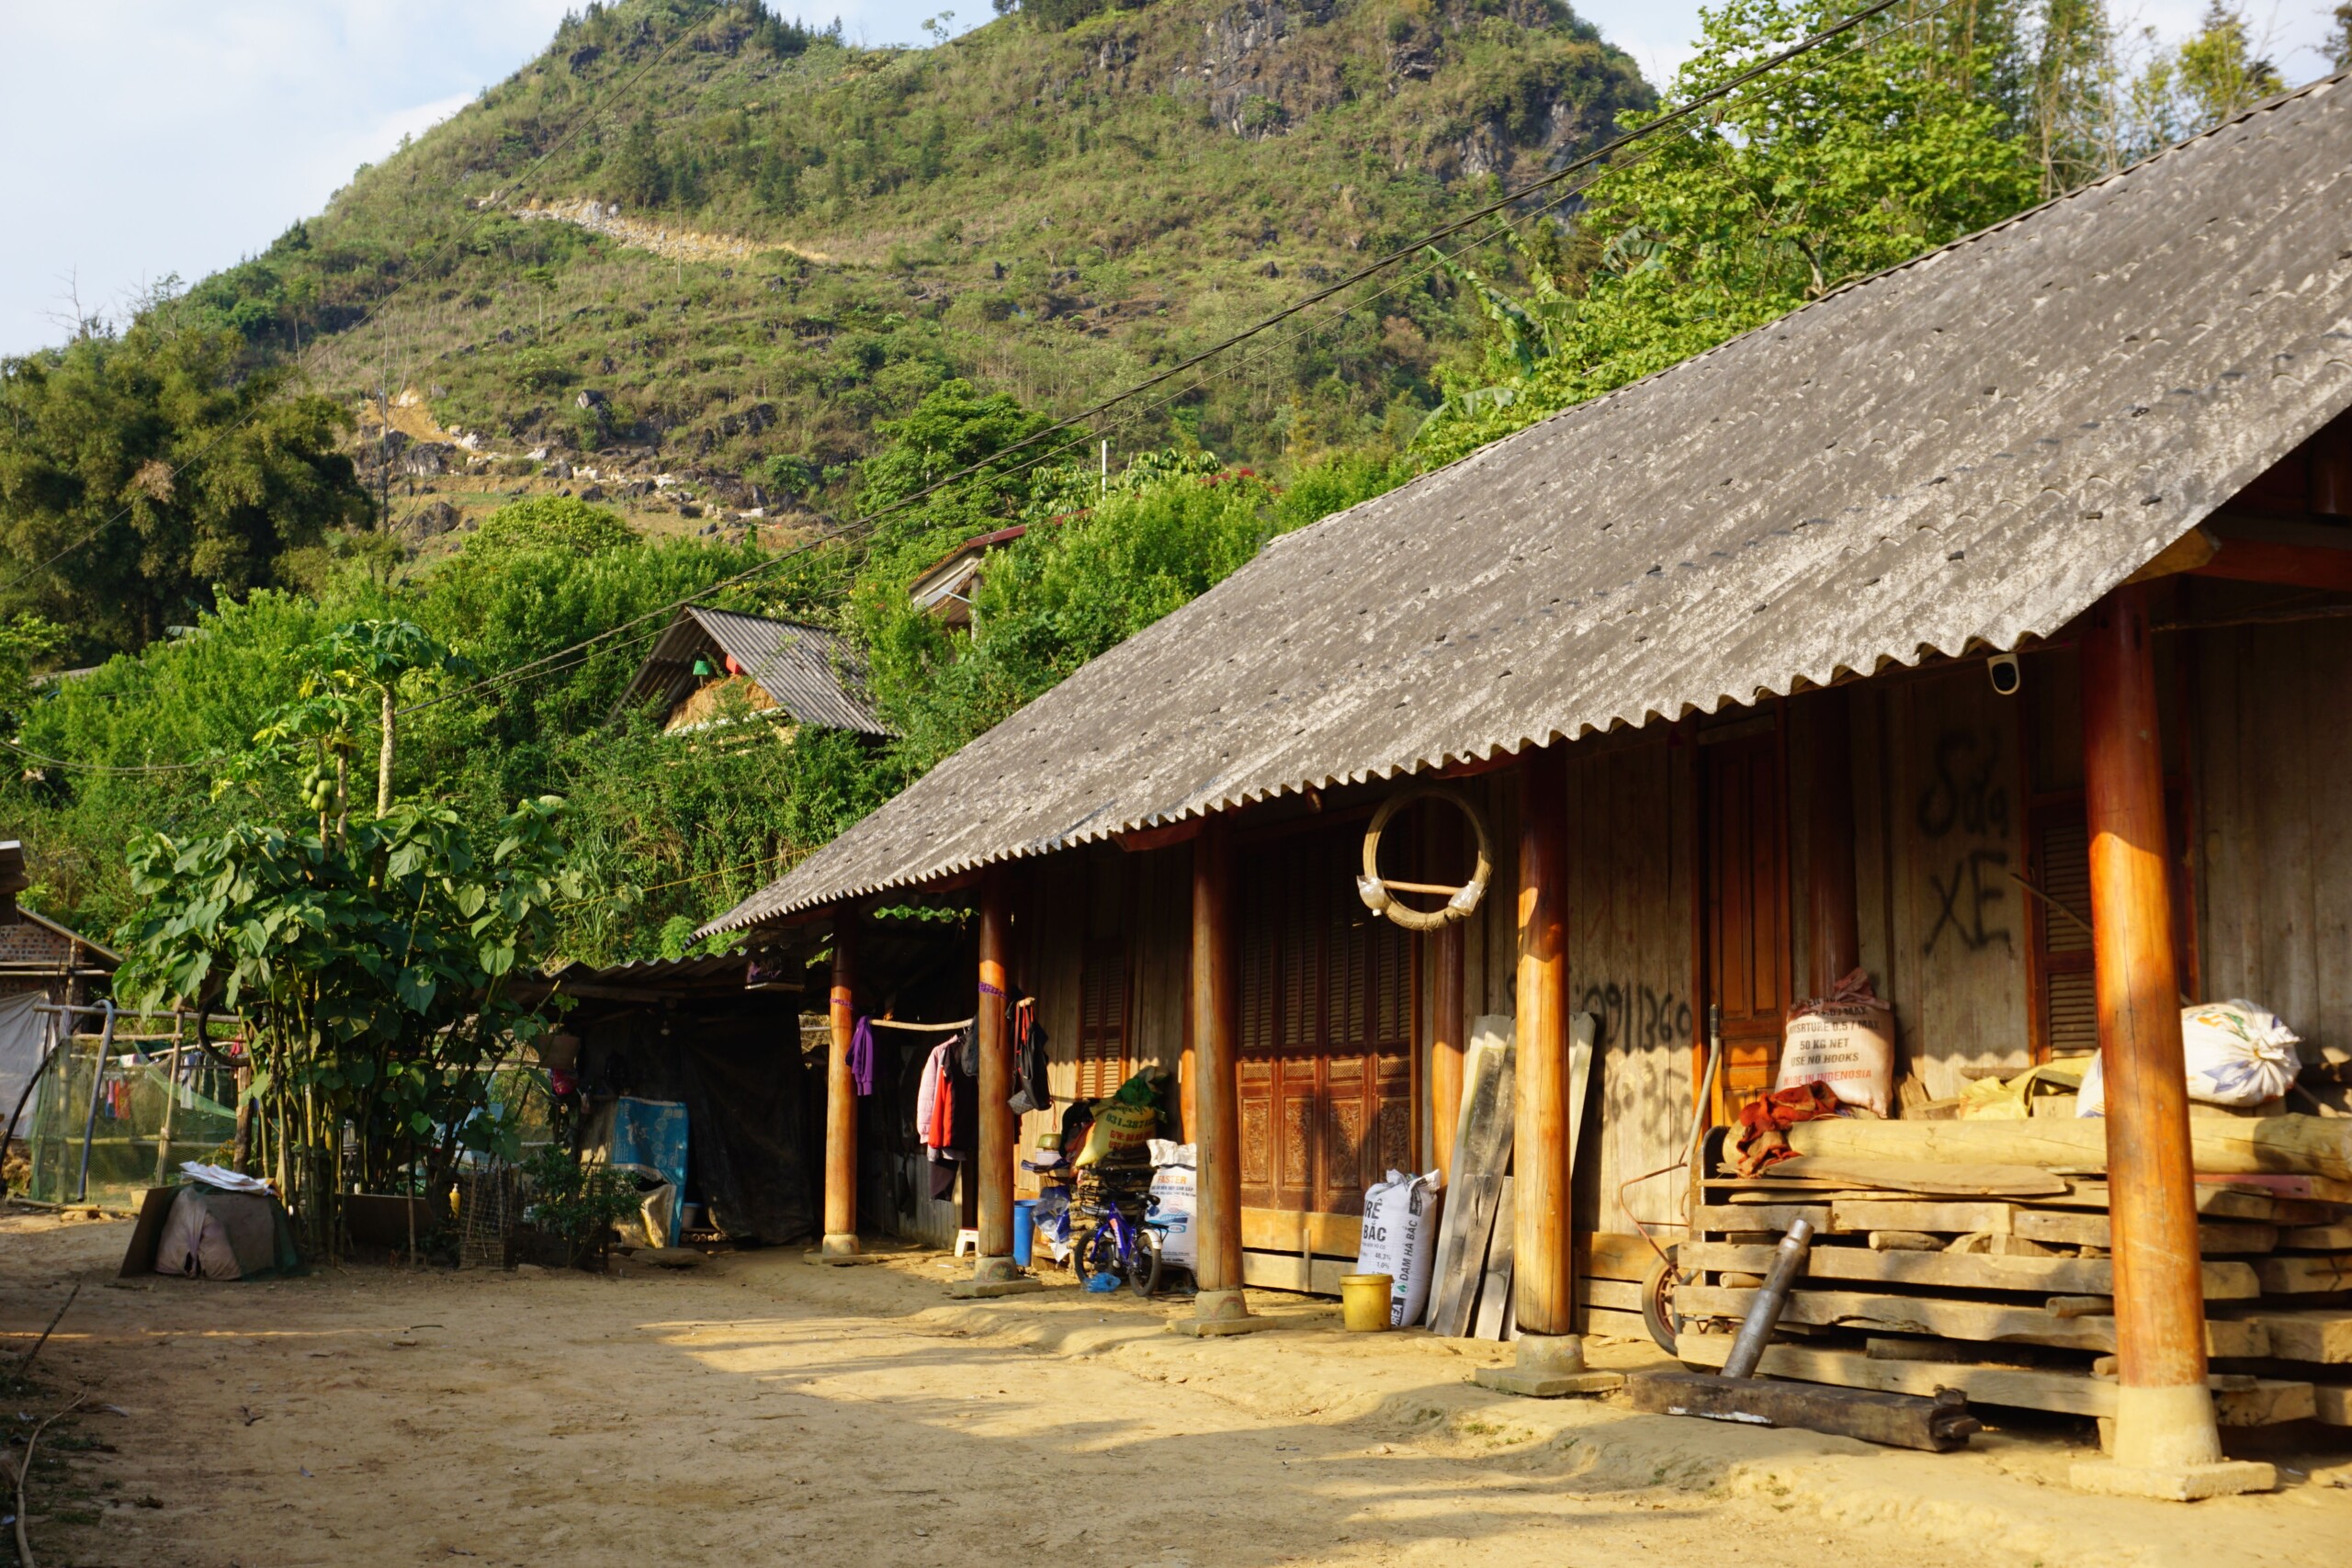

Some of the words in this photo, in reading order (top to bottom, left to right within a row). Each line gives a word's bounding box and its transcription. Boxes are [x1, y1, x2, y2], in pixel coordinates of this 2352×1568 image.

[1923, 849, 2014, 959] XE
[1844, 1006, 1868, 1016] MAX
[1858, 1020, 1879, 1030] MAX
[1800, 1040, 1810, 1050] 50
[1813, 1040, 1826, 1050] KG
[1829, 1038, 1849, 1048] NET
[1791, 1056, 1805, 1066] USE
[1808, 1055, 1820, 1065] NO
[1824, 1053, 1859, 1064] HOOKS
[1783, 1075, 1803, 1087] MADE
[1805, 1074, 1815, 1085] IN
[1817, 1069, 1871, 1082] INDENOSIA
[1158, 1175, 1187, 1184] FASTER
[1364, 1198, 1383, 1219] RÊ
[1363, 1220, 1386, 1242] BẮC
[1403, 1220, 1418, 1240] BẮC
